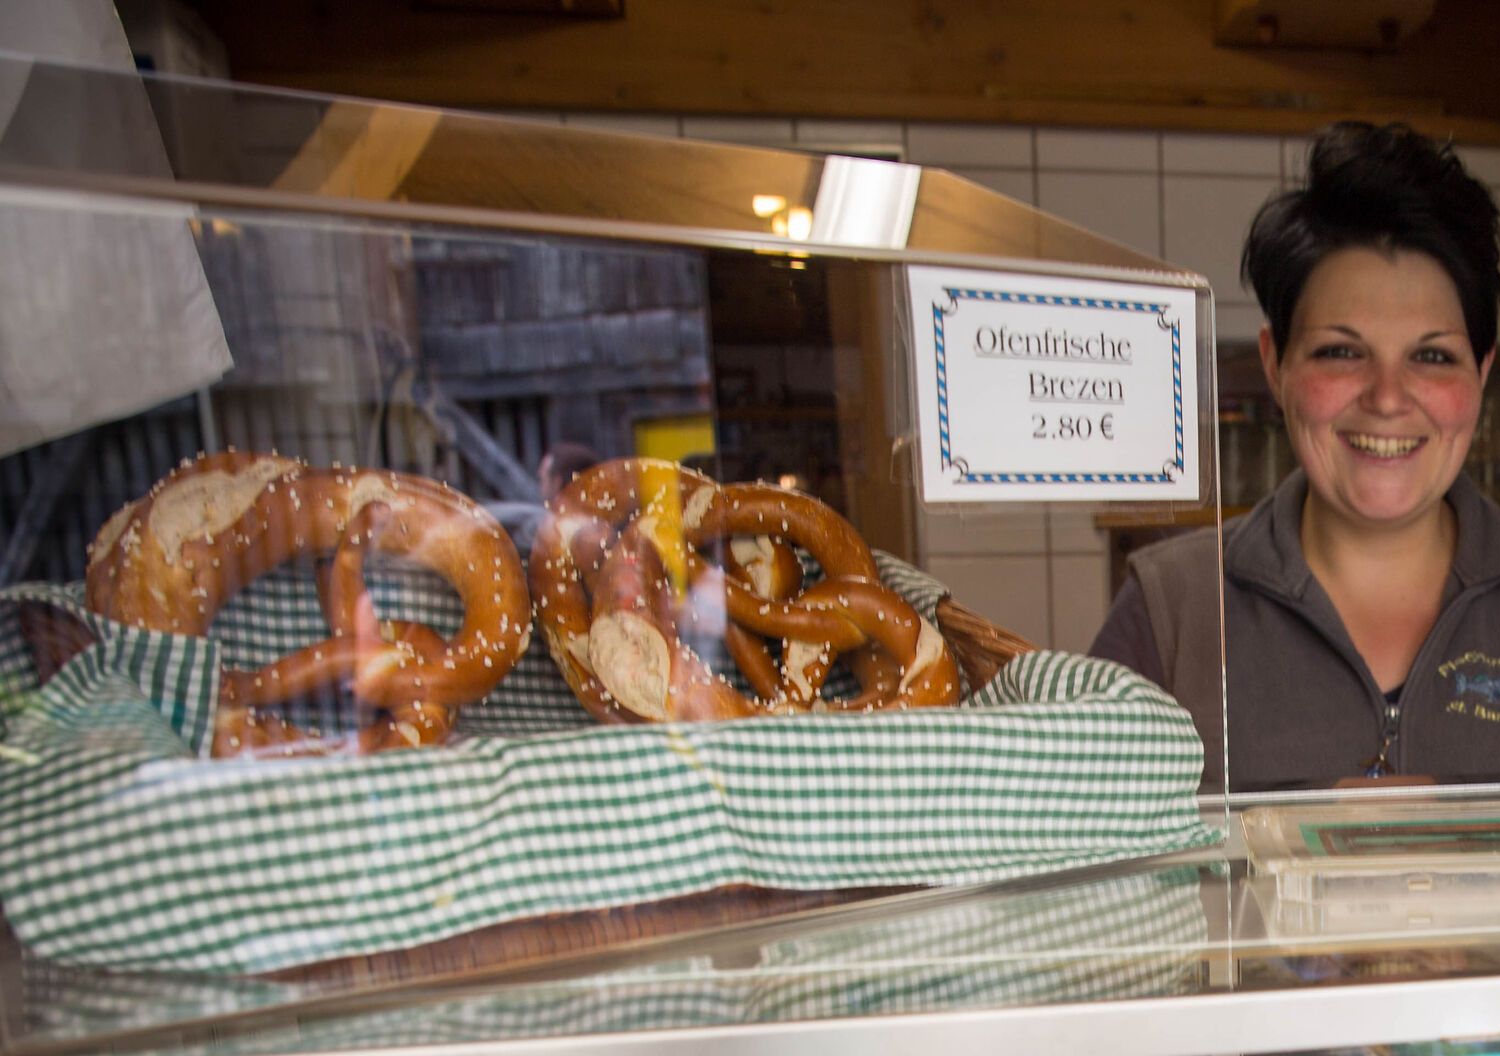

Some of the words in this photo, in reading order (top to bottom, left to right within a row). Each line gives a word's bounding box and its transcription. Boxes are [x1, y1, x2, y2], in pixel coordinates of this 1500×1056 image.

[975, 327, 1132, 359] Ofenfrische
[1030, 373, 1123, 400] Brezen
[1032, 415, 1092, 439] 2.80
[1100, 414, 1114, 439] €
